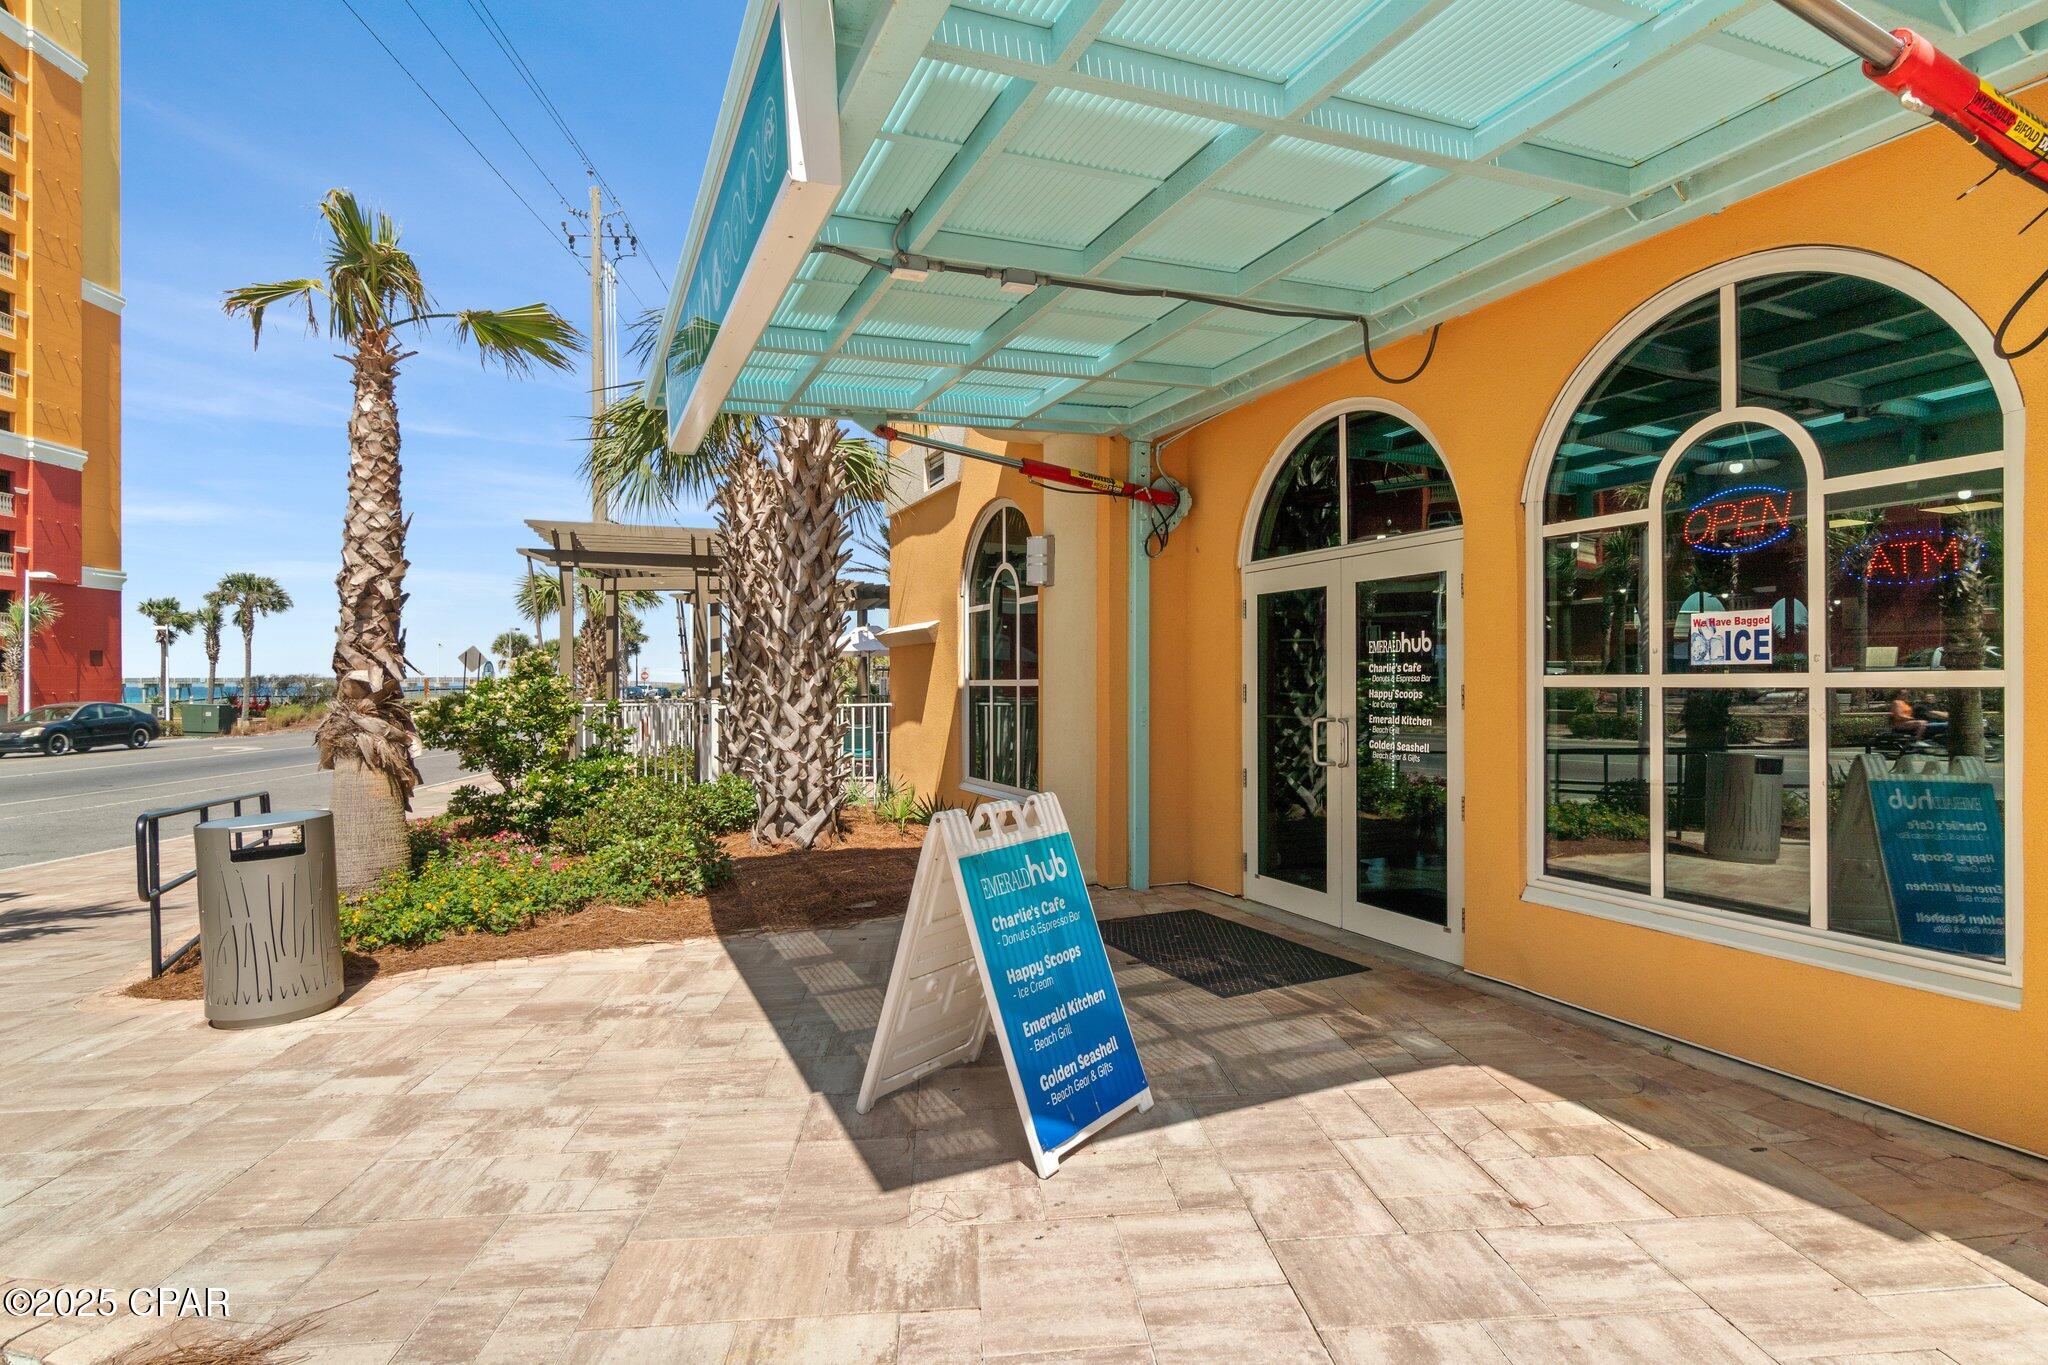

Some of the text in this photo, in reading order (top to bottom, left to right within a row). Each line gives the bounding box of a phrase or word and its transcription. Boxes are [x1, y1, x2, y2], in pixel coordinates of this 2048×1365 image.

[2013, 119, 2040, 143] BIFOLD
[1683, 491, 1793, 545] OPEN
[1866, 537, 1960, 577] ATM
[1693, 615, 1770, 628] We Have Bagged
[1725, 629, 1770, 662] ICE
[1369, 662, 1422, 673] Charlie's Cafe
[1421, 674, 1431, 682] Bar
[1369, 689, 1423, 701] Happy Scoops
[1369, 714, 1432, 726] Emerald Kitchen
[1369, 740, 1430, 753] Golden Seashell
[992, 896, 1066, 932] Charlie's Cafe
[1001, 929, 1030, 947] Donuts
[1030, 925, 1037, 936] &
[1037, 915, 1068, 934] Espresso
[1068, 911, 1080, 923] Bar
[1006, 945, 1082, 985] Happy Scoops
[1017, 988, 1030, 999] Ice
[1029, 976, 1055, 994] Cream
[1022, 988, 1106, 1037] Emerald Kitchen
[1034, 1031, 1058, 1052] Beach
[1057, 1022, 1073, 1039] Grill
[1039, 1035, 1119, 1092] Golden Seashell
[1050, 1084, 1074, 1106] Beach
[1073, 1075, 1090, 1092] Gear
[1090, 1070, 1097, 1082] &
[1097, 1062, 1114, 1078] Gifts
